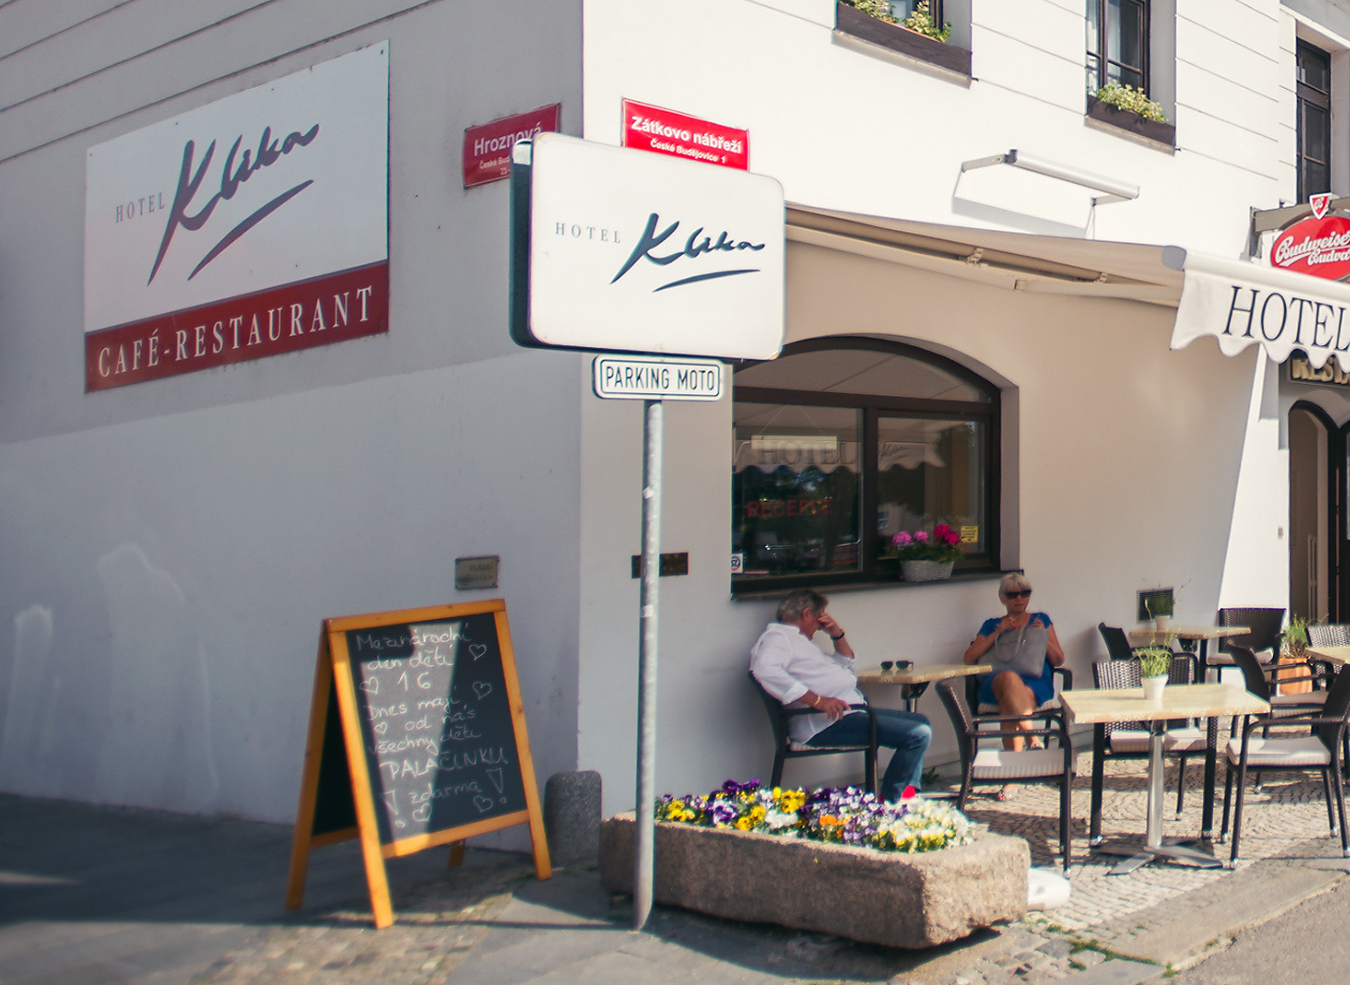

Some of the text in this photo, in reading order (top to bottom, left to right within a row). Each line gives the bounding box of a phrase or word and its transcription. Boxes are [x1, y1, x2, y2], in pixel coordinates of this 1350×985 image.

[631, 116, 742, 153] Zátkovo nábřeží
[650, 138, 675, 152] České
[676, 145, 718, 162] Budějovice
[115, 192, 165, 223] HOTEL
[555, 212, 766, 285] HOTEL Klika
[98, 285, 372, 378] CAFÉ-RESTAURANT
[606, 366, 715, 391] PARKING MOTO
[368, 654, 402, 671] den
[367, 703, 408, 720] Dnes
[405, 715, 432, 731] od
